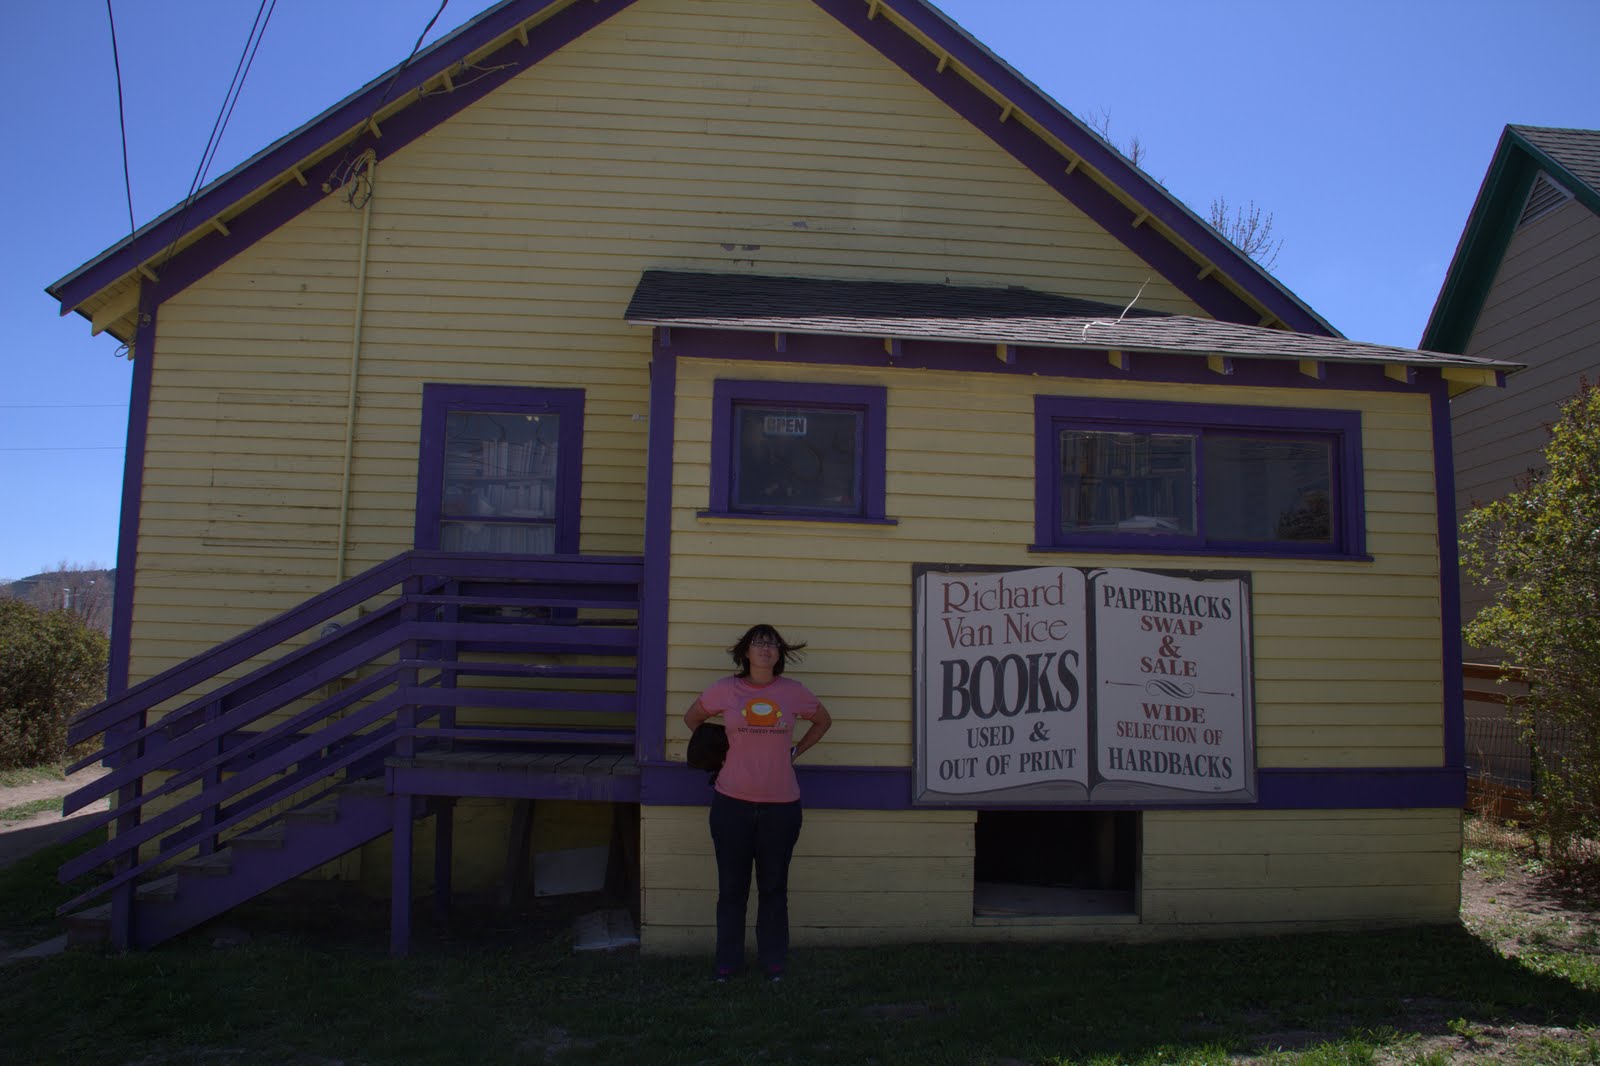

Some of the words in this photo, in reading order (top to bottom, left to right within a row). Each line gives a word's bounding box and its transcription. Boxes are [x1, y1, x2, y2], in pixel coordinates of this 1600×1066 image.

[766, 417, 804, 432] OPEN
[942, 573, 1064, 613] Richard
[1103, 585, 1231, 620] PAPERBACKS
[943, 617, 993, 649] Van
[1003, 612, 1068, 644] Nice
[1141, 615, 1203, 636] SWAP
[1159, 636, 1181, 658] &
[1141, 657, 1197, 677] SALE
[938, 650, 1079, 721] BOOKS
[1142, 703, 1205, 723] WIDE
[967, 725, 1014, 748] USED
[1029, 721, 1050, 742] &
[1117, 721, 1197, 744] SELECTION
[1204, 728, 1222, 745] OF
[940, 758, 978, 780] OUT
[986, 755, 1011, 776] OF
[1020, 748, 1076, 773] PRINT
[1108, 747, 1232, 779] HARDBACKS
